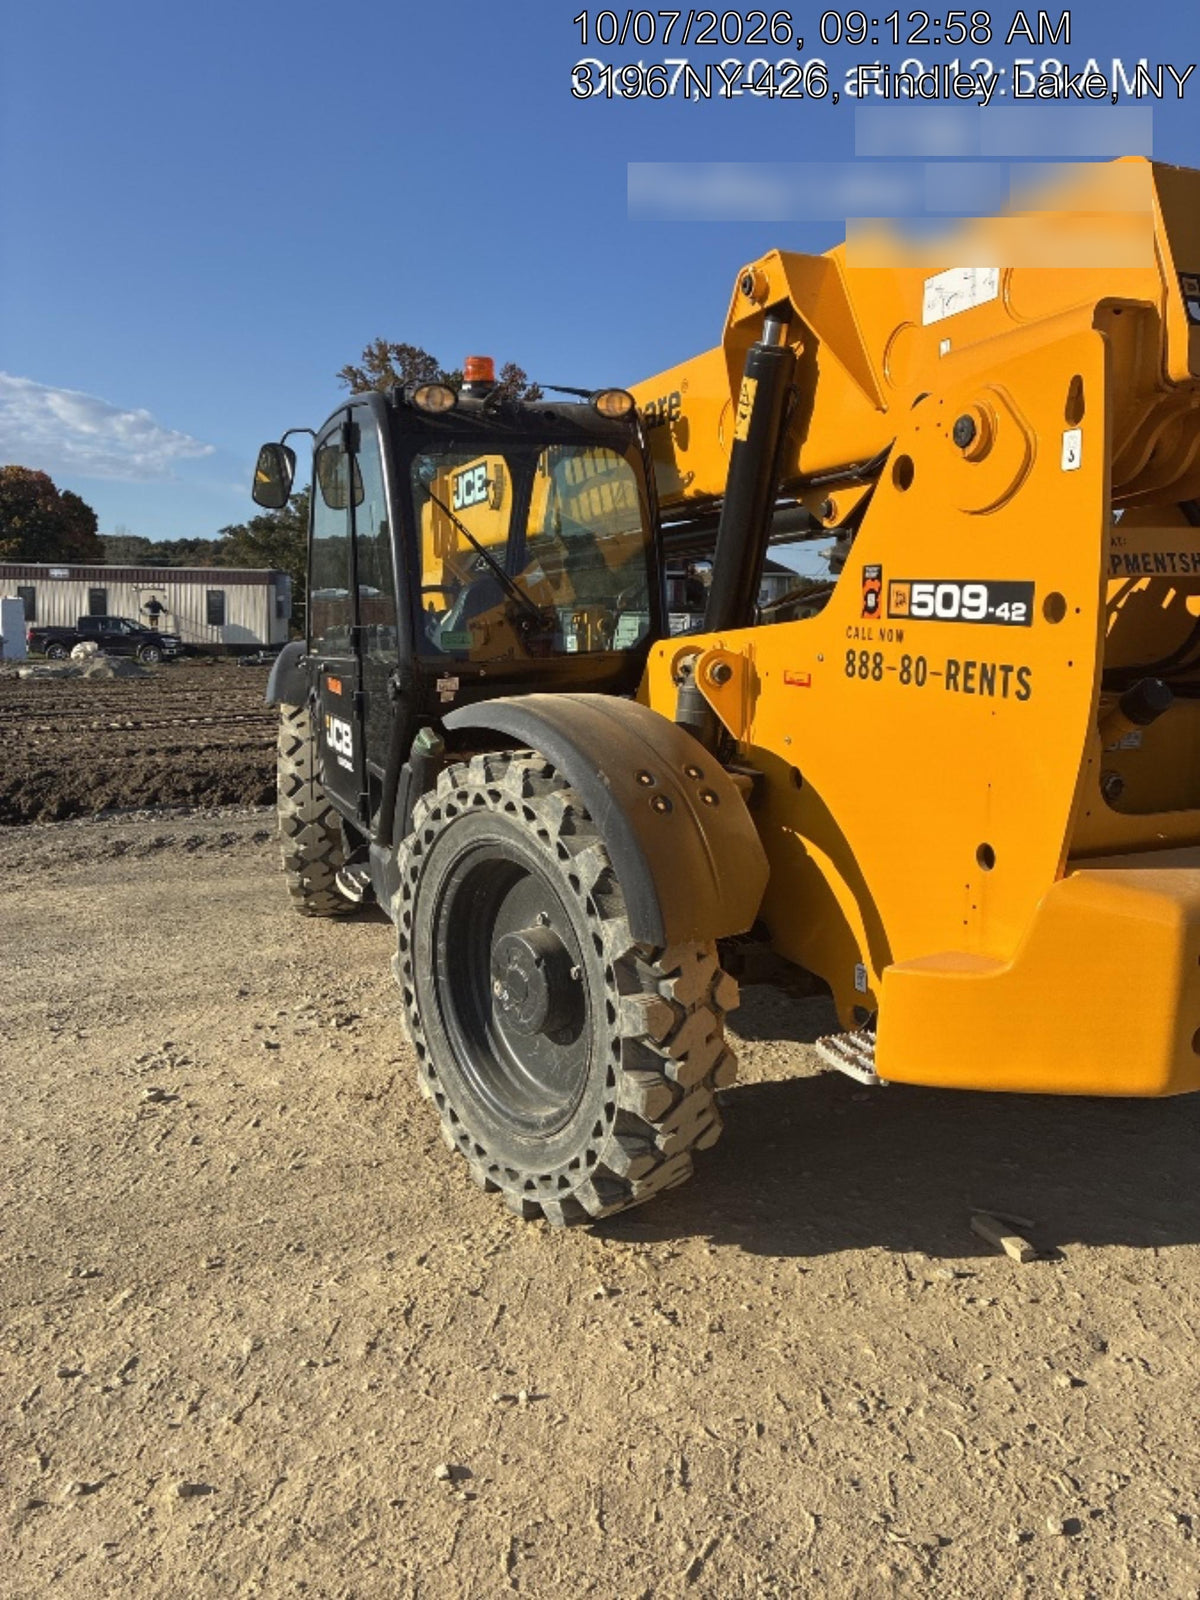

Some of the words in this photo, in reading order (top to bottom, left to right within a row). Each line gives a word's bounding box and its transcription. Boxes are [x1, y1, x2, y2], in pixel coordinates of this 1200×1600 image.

[638, 390, 682, 428] are
[453, 465, 488, 510] JCB
[1107, 552, 1200, 575] PMENTSH
[910, 583, 1027, 622] 509-42
[846, 625, 874, 641] CALL
[879, 628, 905, 643] NOW
[845, 649, 1032, 701] 888-80-RENTS
[325, 714, 353, 758] JCB
